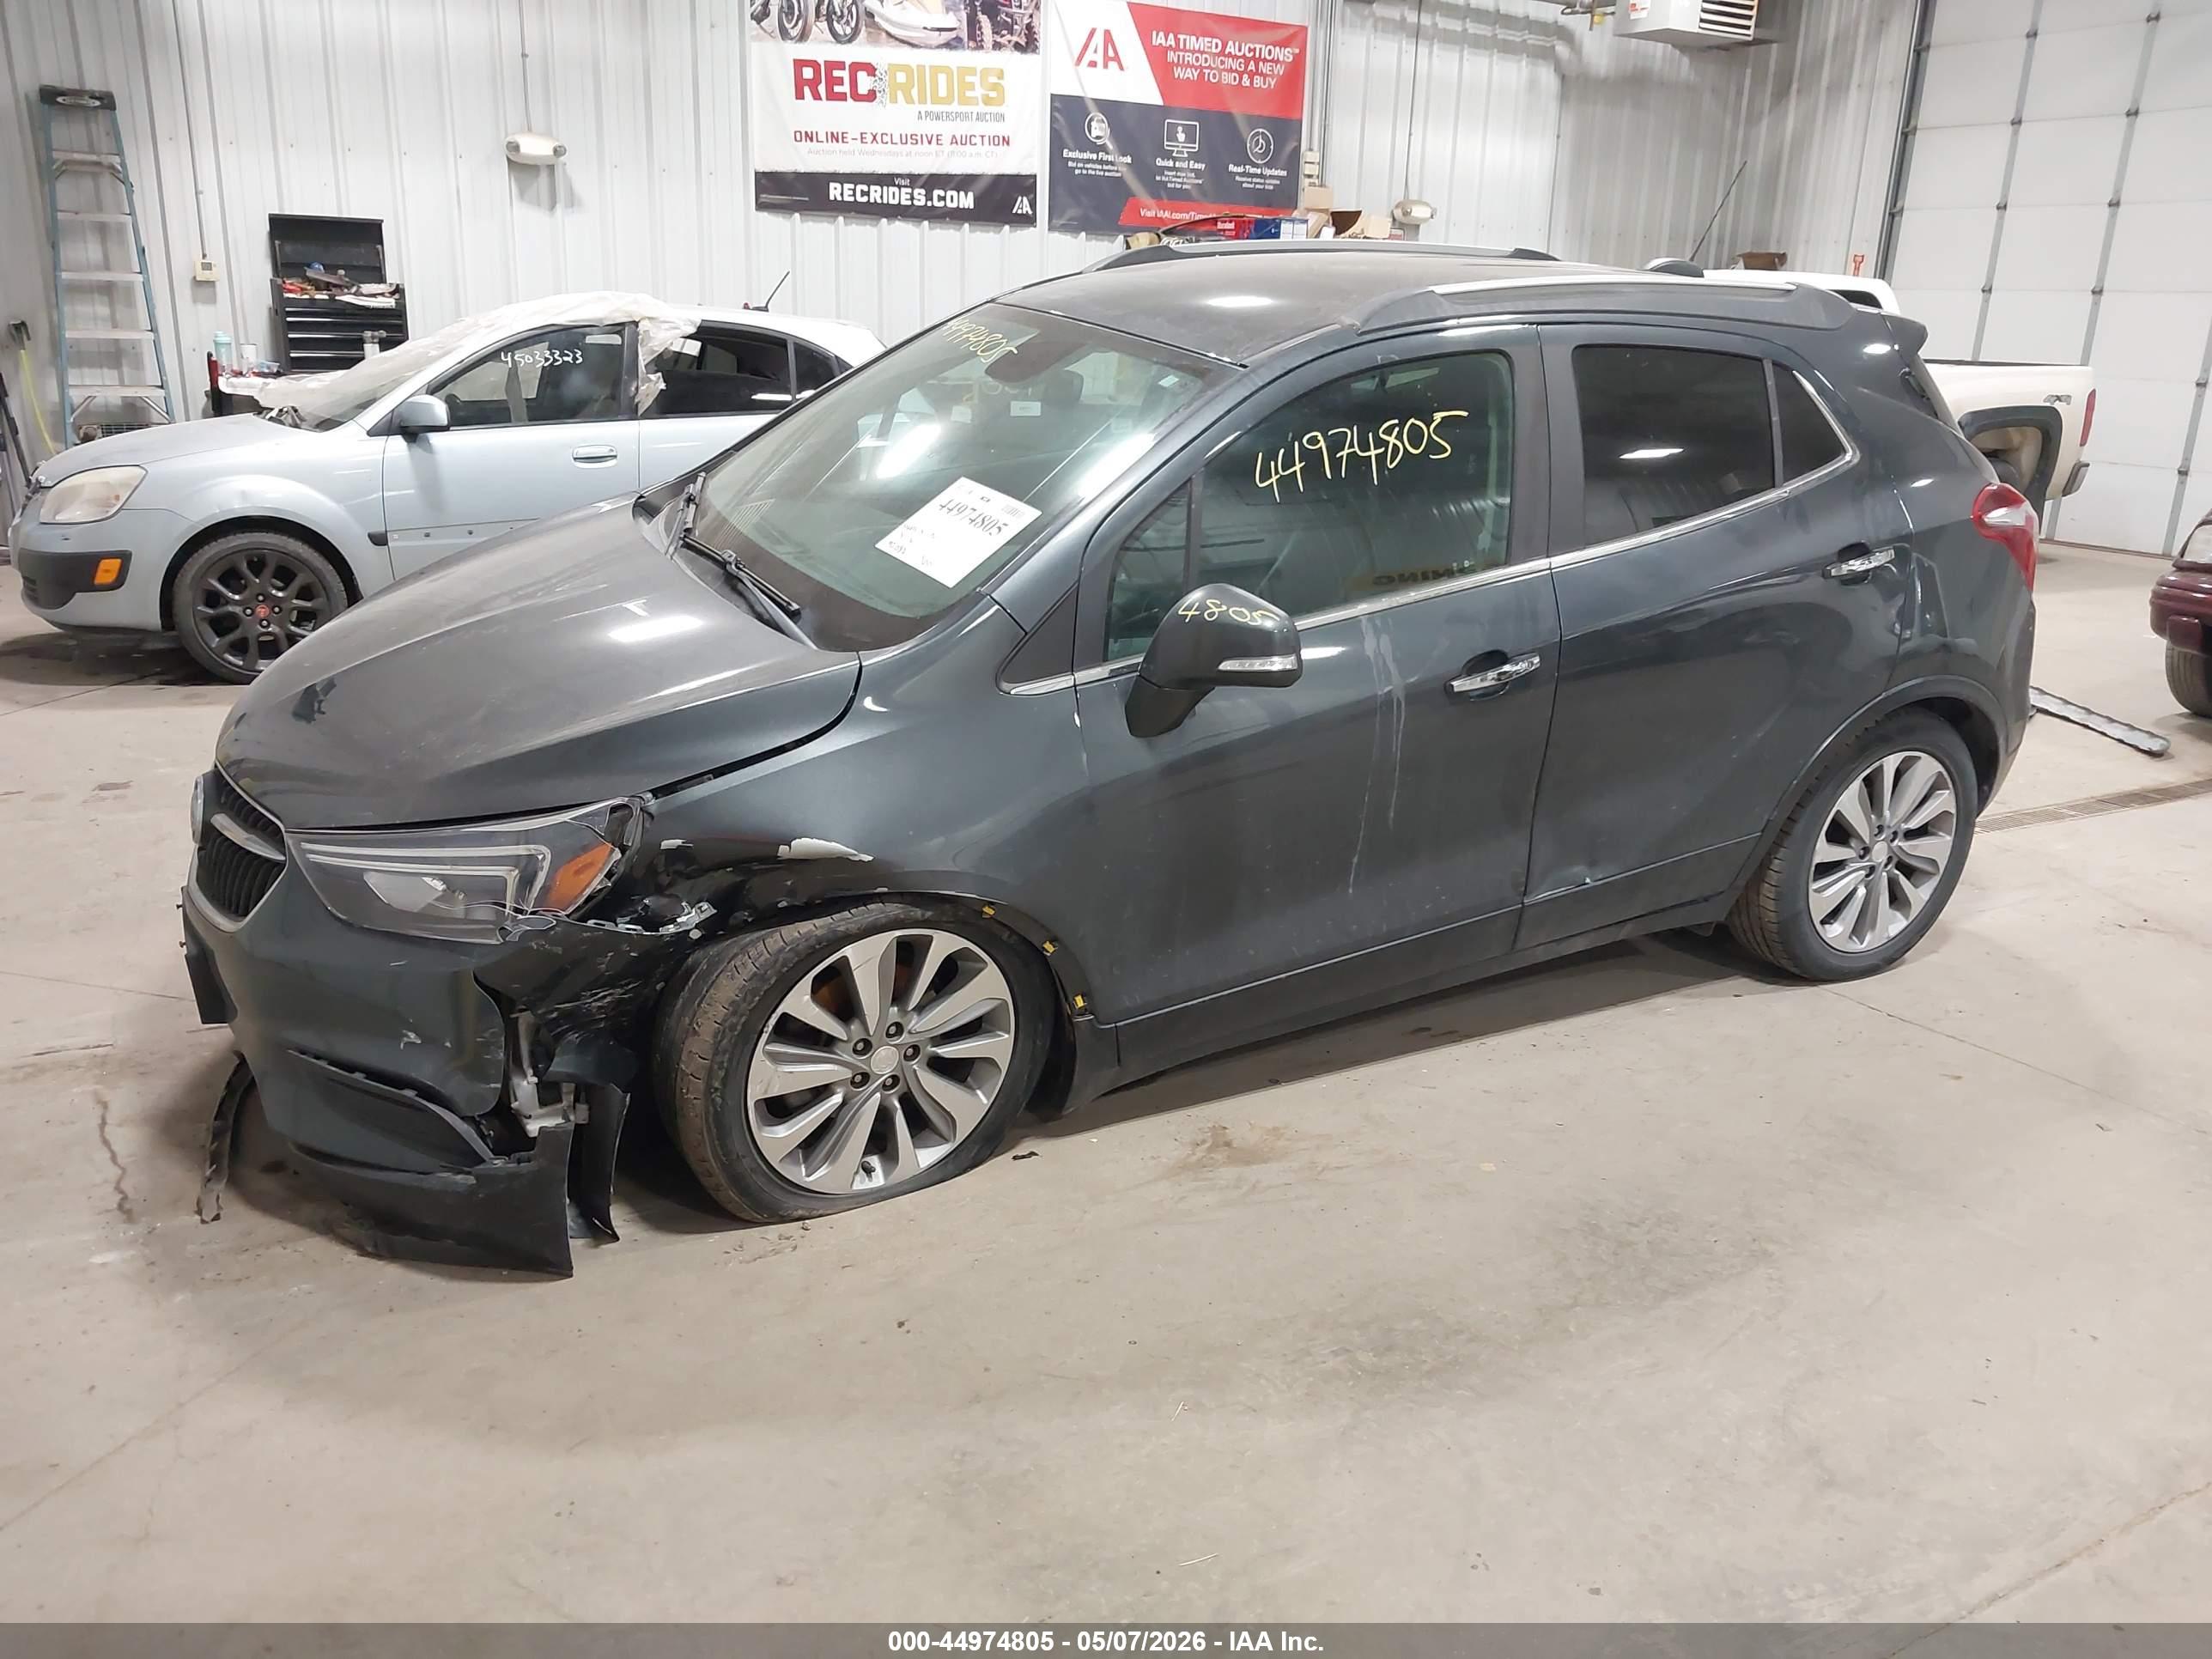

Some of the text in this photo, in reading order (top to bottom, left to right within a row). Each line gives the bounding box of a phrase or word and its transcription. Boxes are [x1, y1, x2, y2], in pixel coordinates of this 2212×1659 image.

[1152, 30, 1176, 48] IAA
[1177, 34, 1222, 53] TIMED
[1167, 51, 1285, 76] INTRODUCING A NEW
[793, 58, 1006, 106] REC RIDES
[1174, 66, 1277, 89] WAY TO BID & BUY
[917, 110, 1006, 123] A POWERSPORT AUCTION
[793, 131, 1011, 147] ONLINE-EXCLUSIVE AUCTION
[807, 148, 836, 156] Auction
[858, 149, 902, 158] Wednesdays
[1063, 149, 1097, 161] Exclusive
[1098, 151, 1115, 161] First
[1156, 157, 1206, 171] Quick and Easy
[1228, 163, 1287, 177] Real-Time Updates
[894, 178, 910, 186] Visit
[829, 182, 975, 210] RECRIDES.COM
[1139, 208, 1156, 217] Visit
[501, 349, 584, 368] 45033323
[1255, 410, 1468, 503] 44974805
[939, 498, 1009, 537] 44974805
[1177, 599, 1280, 626] 4805
